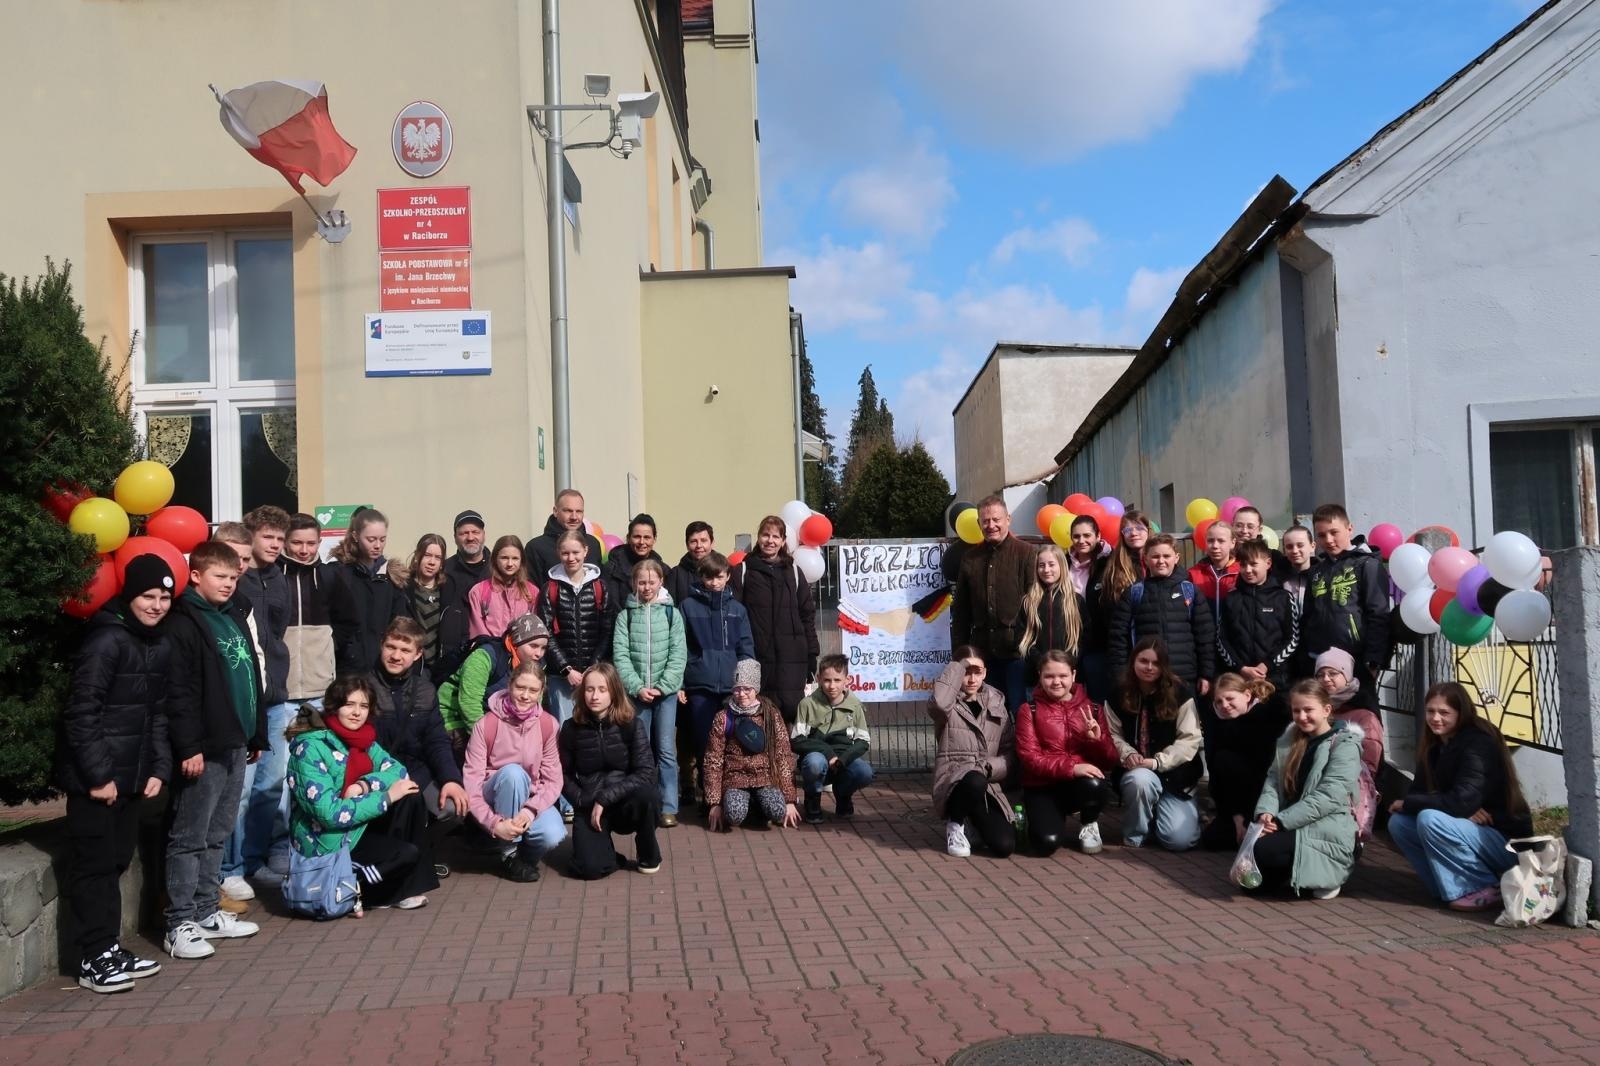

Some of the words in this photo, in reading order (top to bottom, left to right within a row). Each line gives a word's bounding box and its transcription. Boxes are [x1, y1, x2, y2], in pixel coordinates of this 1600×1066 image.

[410, 194, 438, 205] ZESPÓŁ
[383, 207, 467, 217] SZKOLNO-PRZEDSZKOLNY
[426, 219, 432, 228] 4
[411, 231, 448, 240] Raciborzu
[382, 260, 407, 269] SZKOŁA
[408, 259, 453, 269] PODSTAWOWA
[394, 273, 406, 281] im.
[407, 272, 424, 281] Jana
[425, 272, 456, 282] Brzechwy
[845, 674, 876, 691] Polen
[879, 677, 898, 691] und
